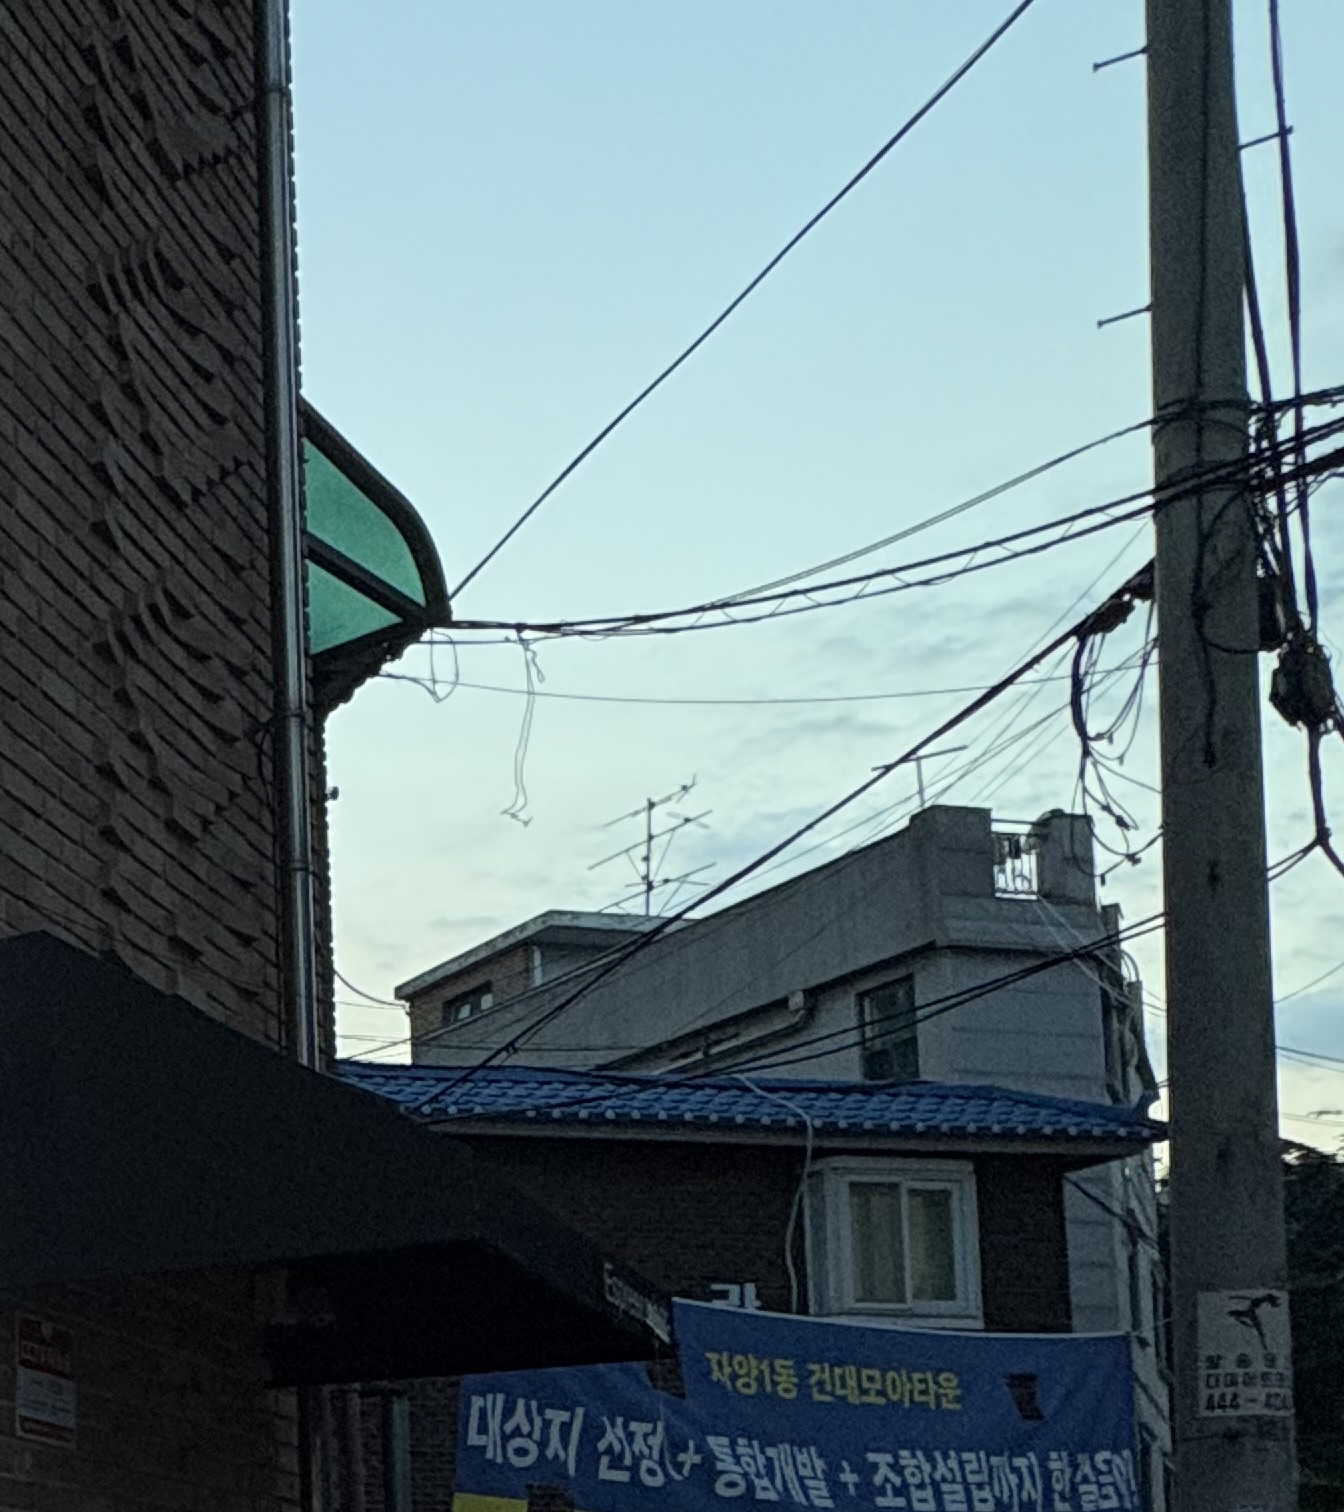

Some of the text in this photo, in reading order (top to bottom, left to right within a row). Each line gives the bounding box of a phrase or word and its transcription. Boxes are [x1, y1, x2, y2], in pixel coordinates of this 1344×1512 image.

[705, 1351, 963, 1411] 자양1동 건대모아타운
[466, 1392, 586, 1478] 대상지
[597, 1414, 667, 1488] 선정
[707, 1434, 834, 1510] 통합개발
[839, 1458, 861, 1498] +
